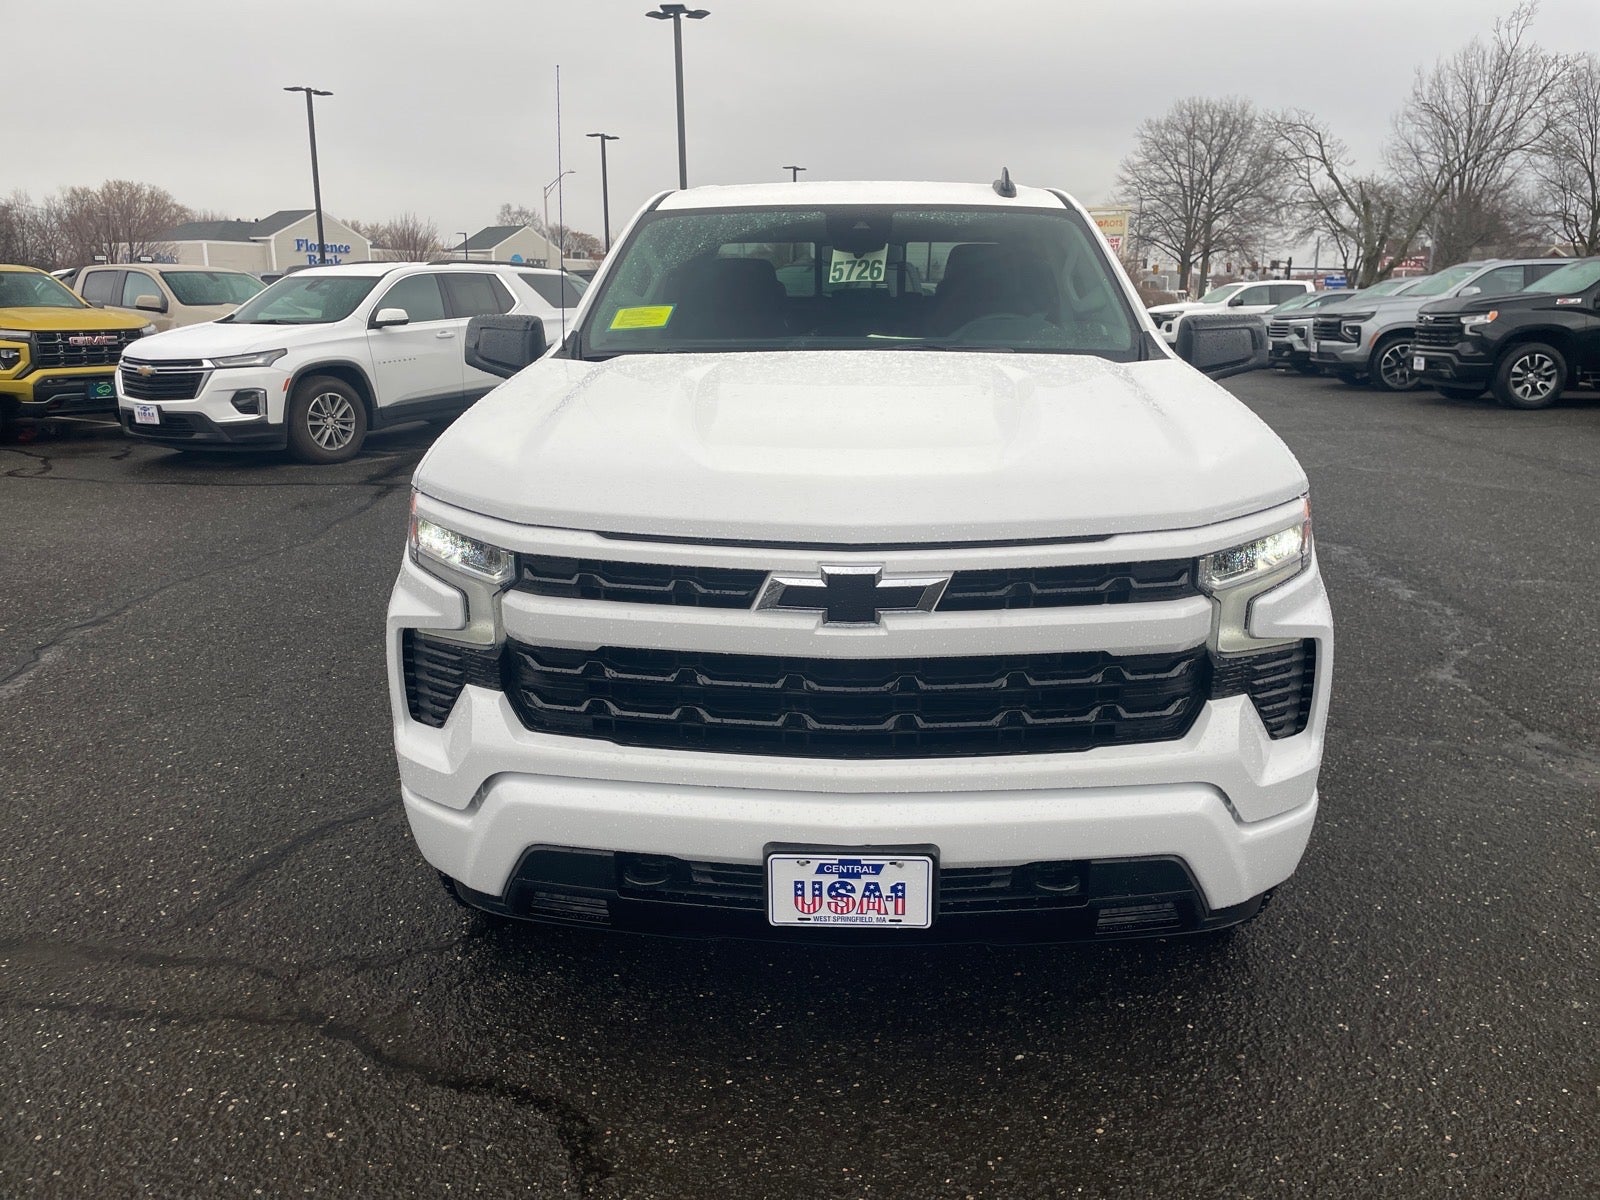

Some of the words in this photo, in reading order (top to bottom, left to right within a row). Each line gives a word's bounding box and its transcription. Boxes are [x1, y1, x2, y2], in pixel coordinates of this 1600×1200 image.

[295, 238, 351, 253] Florence
[831, 259, 883, 282] 5726
[69, 335, 118, 346] GMC
[823, 864, 876, 874] CENTRAL
[813, 915, 831, 923] WEST
